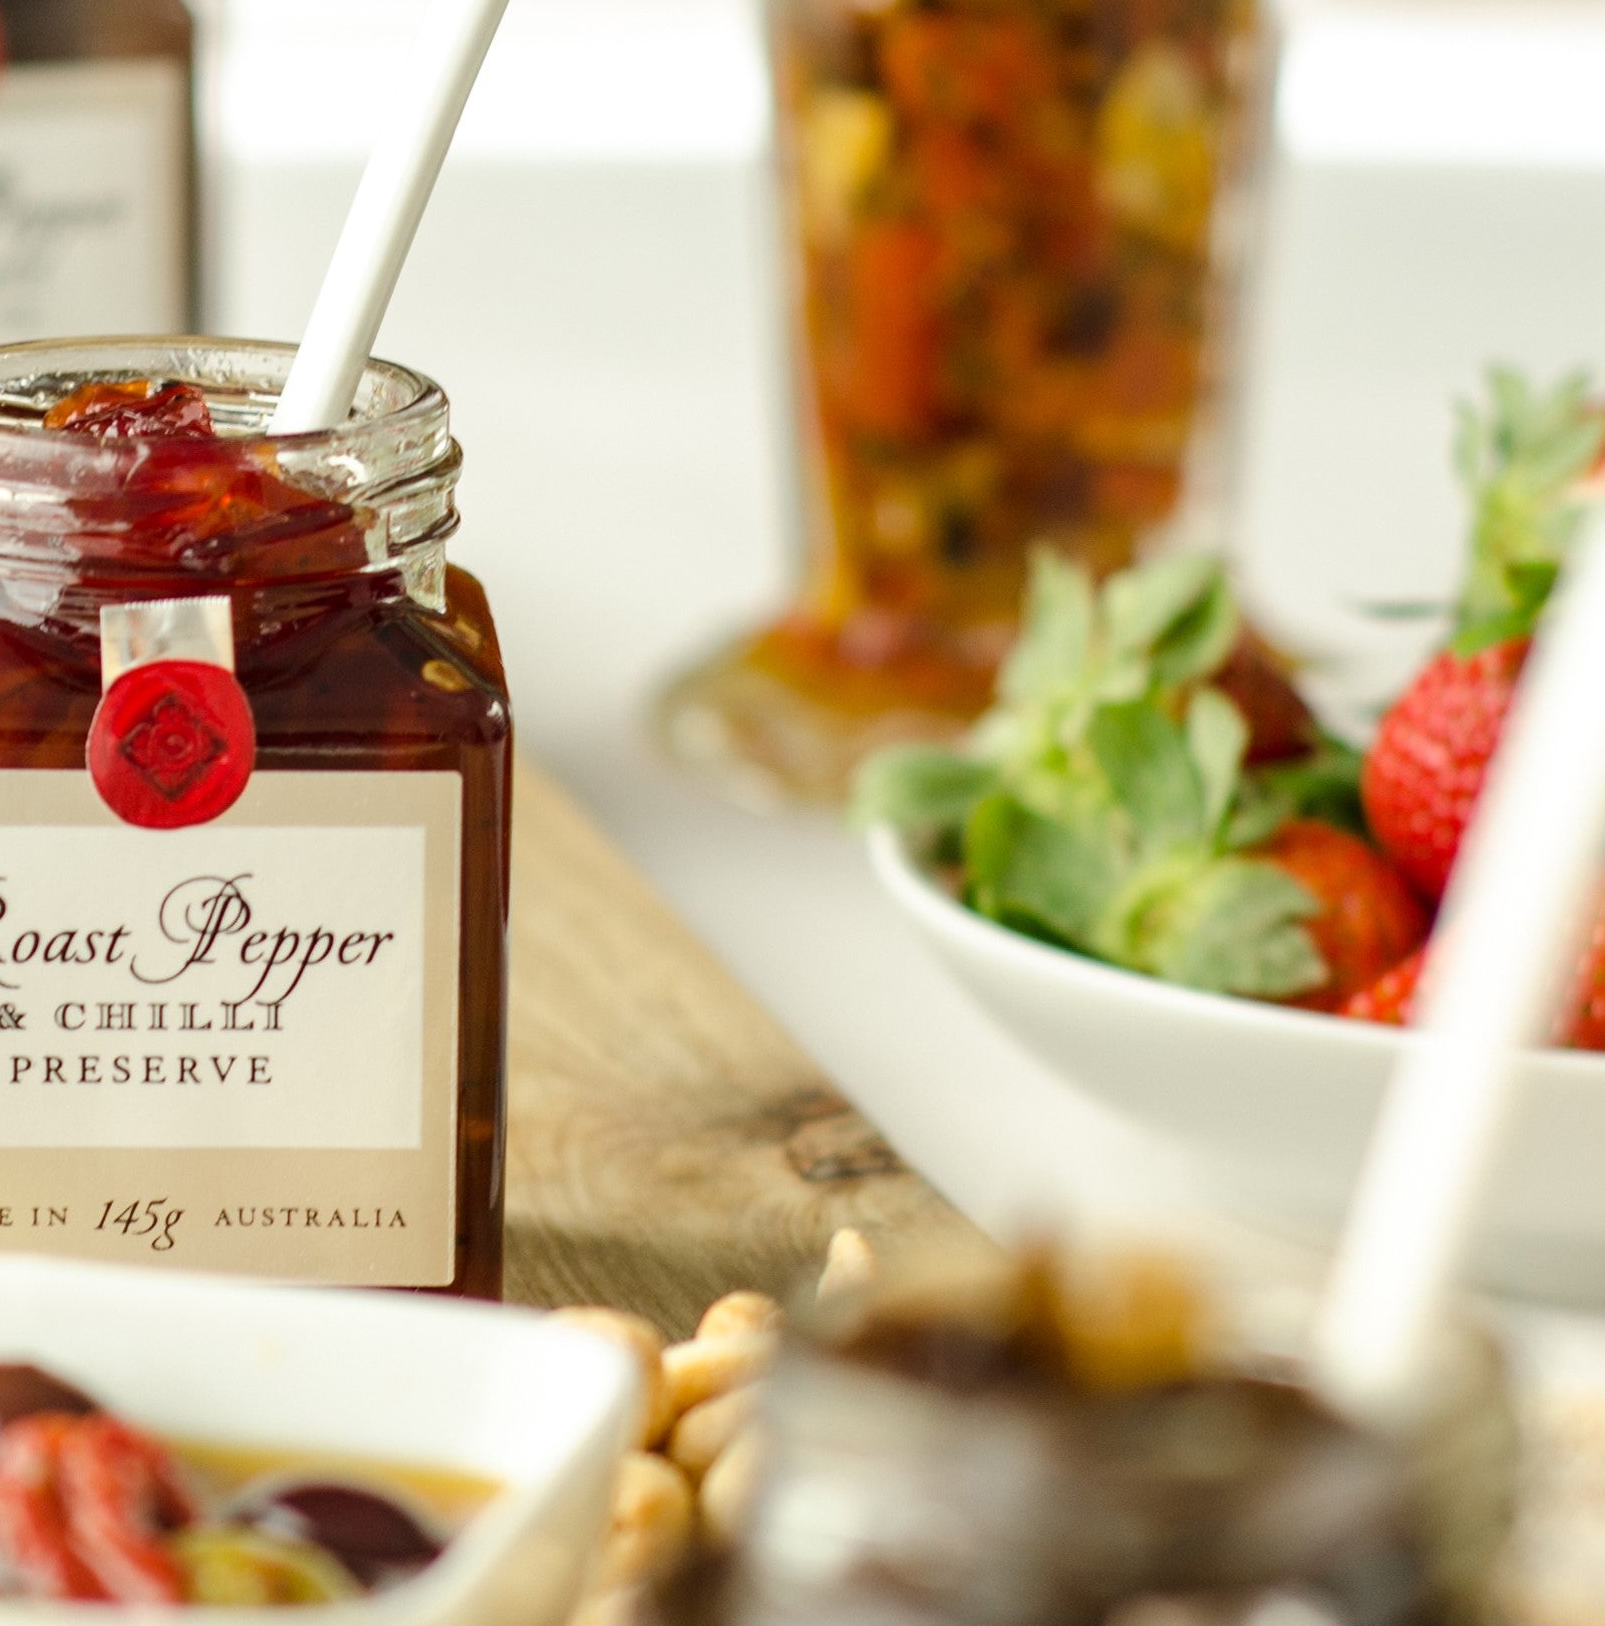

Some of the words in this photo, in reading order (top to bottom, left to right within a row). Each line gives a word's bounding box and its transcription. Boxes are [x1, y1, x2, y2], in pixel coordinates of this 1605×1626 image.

[130, 873, 394, 1005] Pepper
[53, 1002, 285, 1031] CHILLI
[10, 1056, 274, 1085] PRESERVE
[31, 1207, 69, 1227] IN
[94, 1196, 188, 1251] 145g
[214, 1207, 408, 1229] AUSTRALIA
